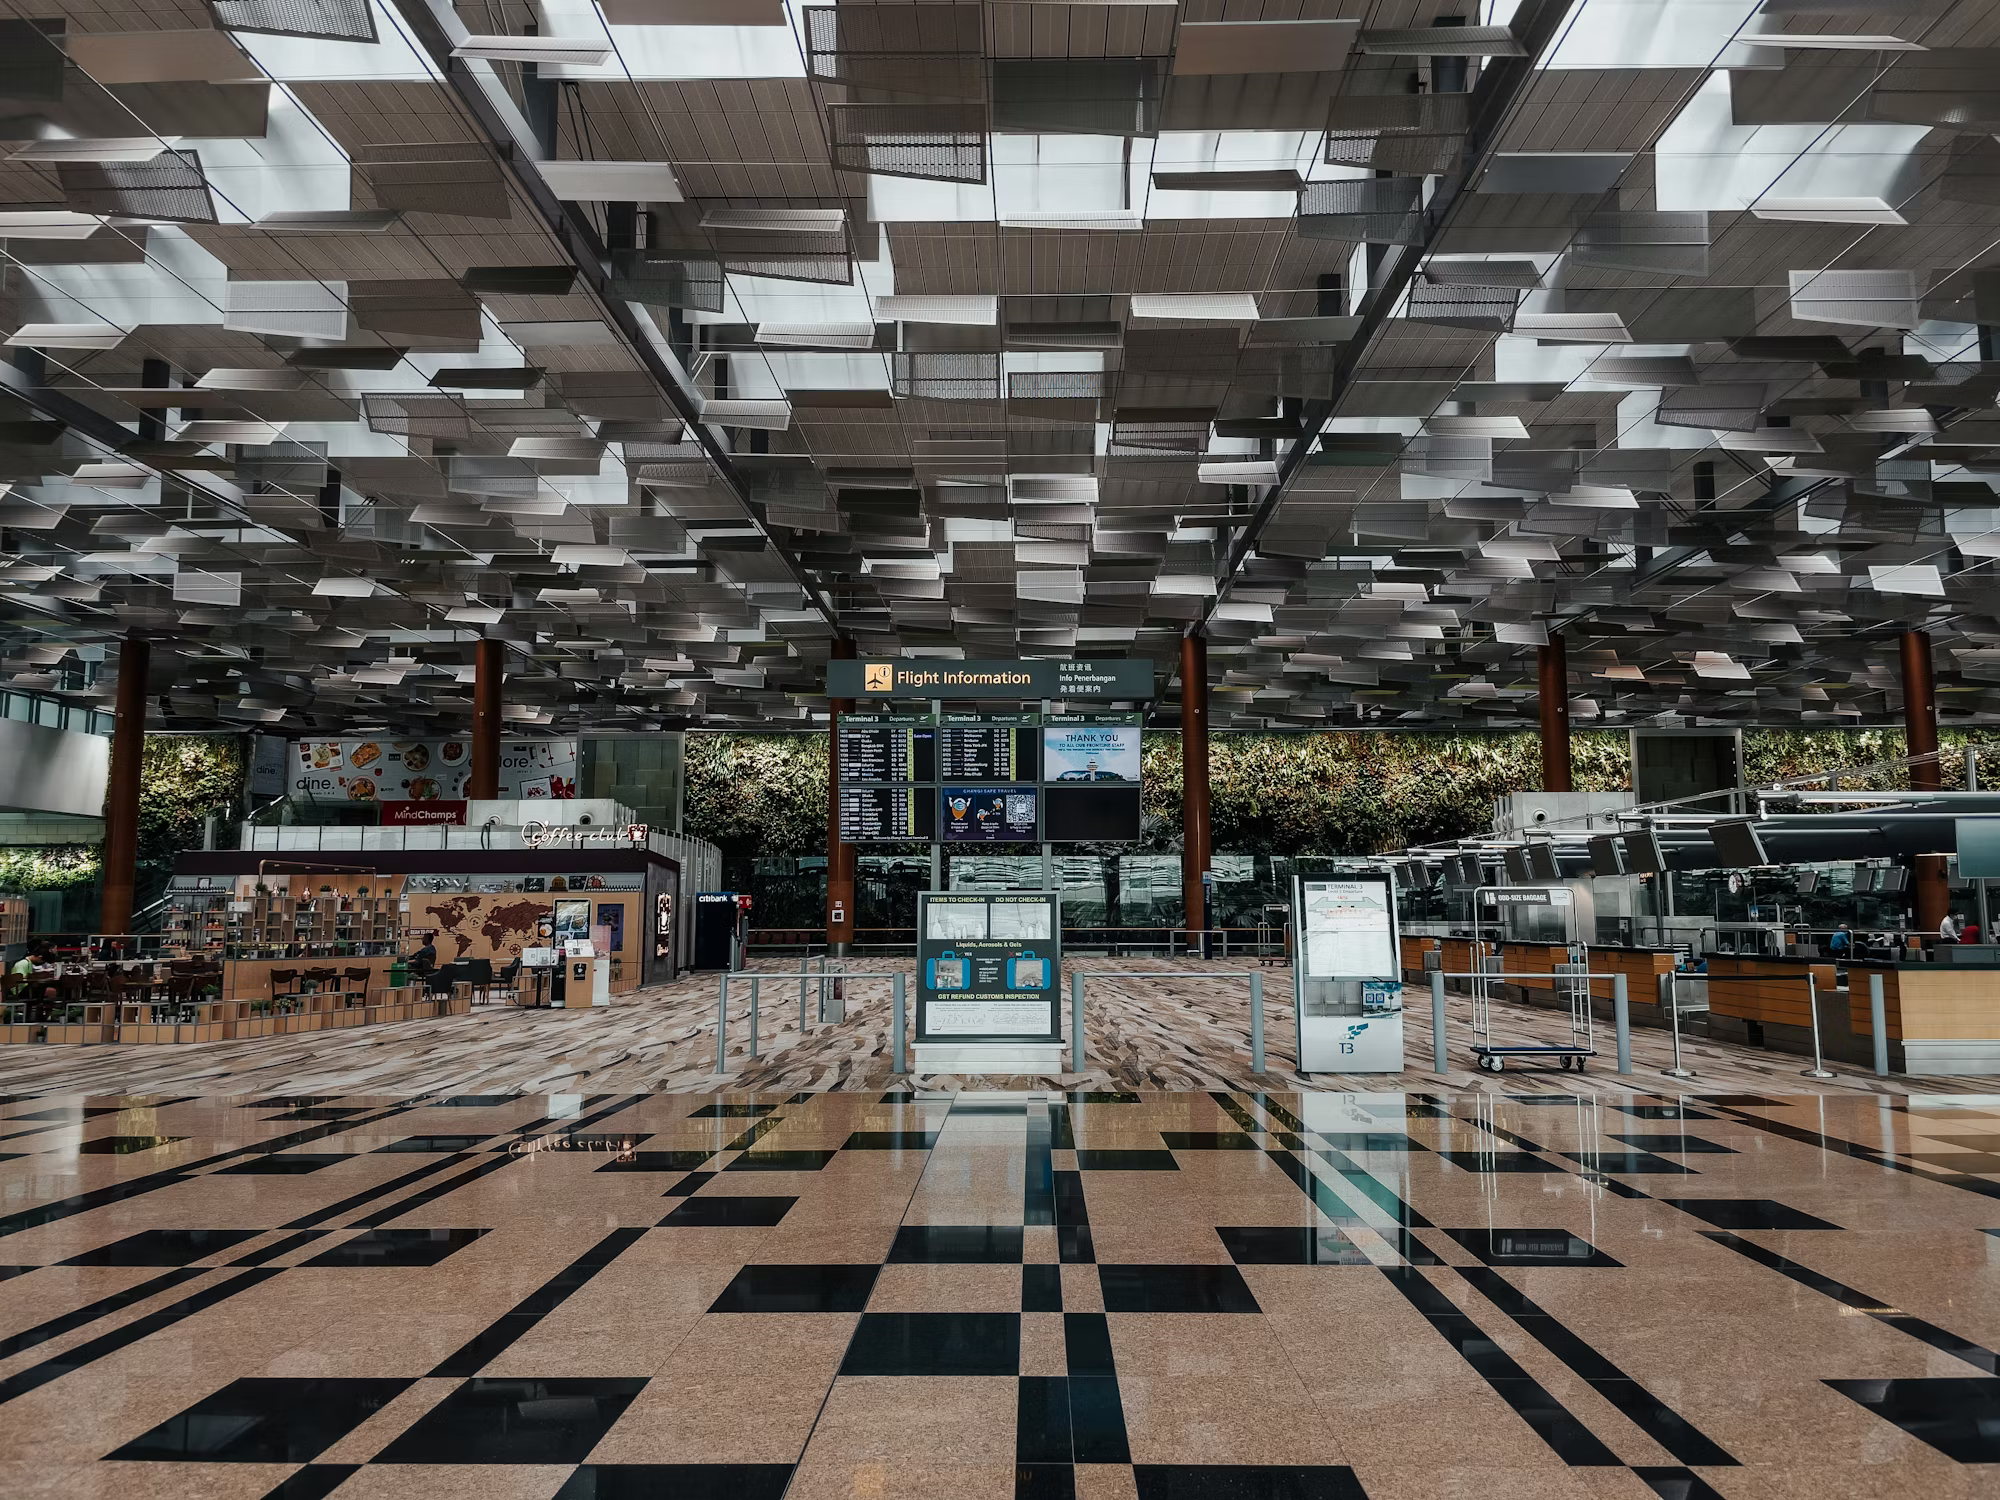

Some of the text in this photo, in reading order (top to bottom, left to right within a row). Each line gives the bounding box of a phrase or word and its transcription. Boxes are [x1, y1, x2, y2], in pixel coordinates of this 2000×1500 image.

[897, 670, 1031, 688] Flight Information
[1074, 674, 1116, 683] Penerbangan
[257, 765, 277, 774] dine.
[296, 777, 335, 790] dine.
[394, 809, 457, 821] MindChamps
[1339, 1043, 1354, 1054] T3
